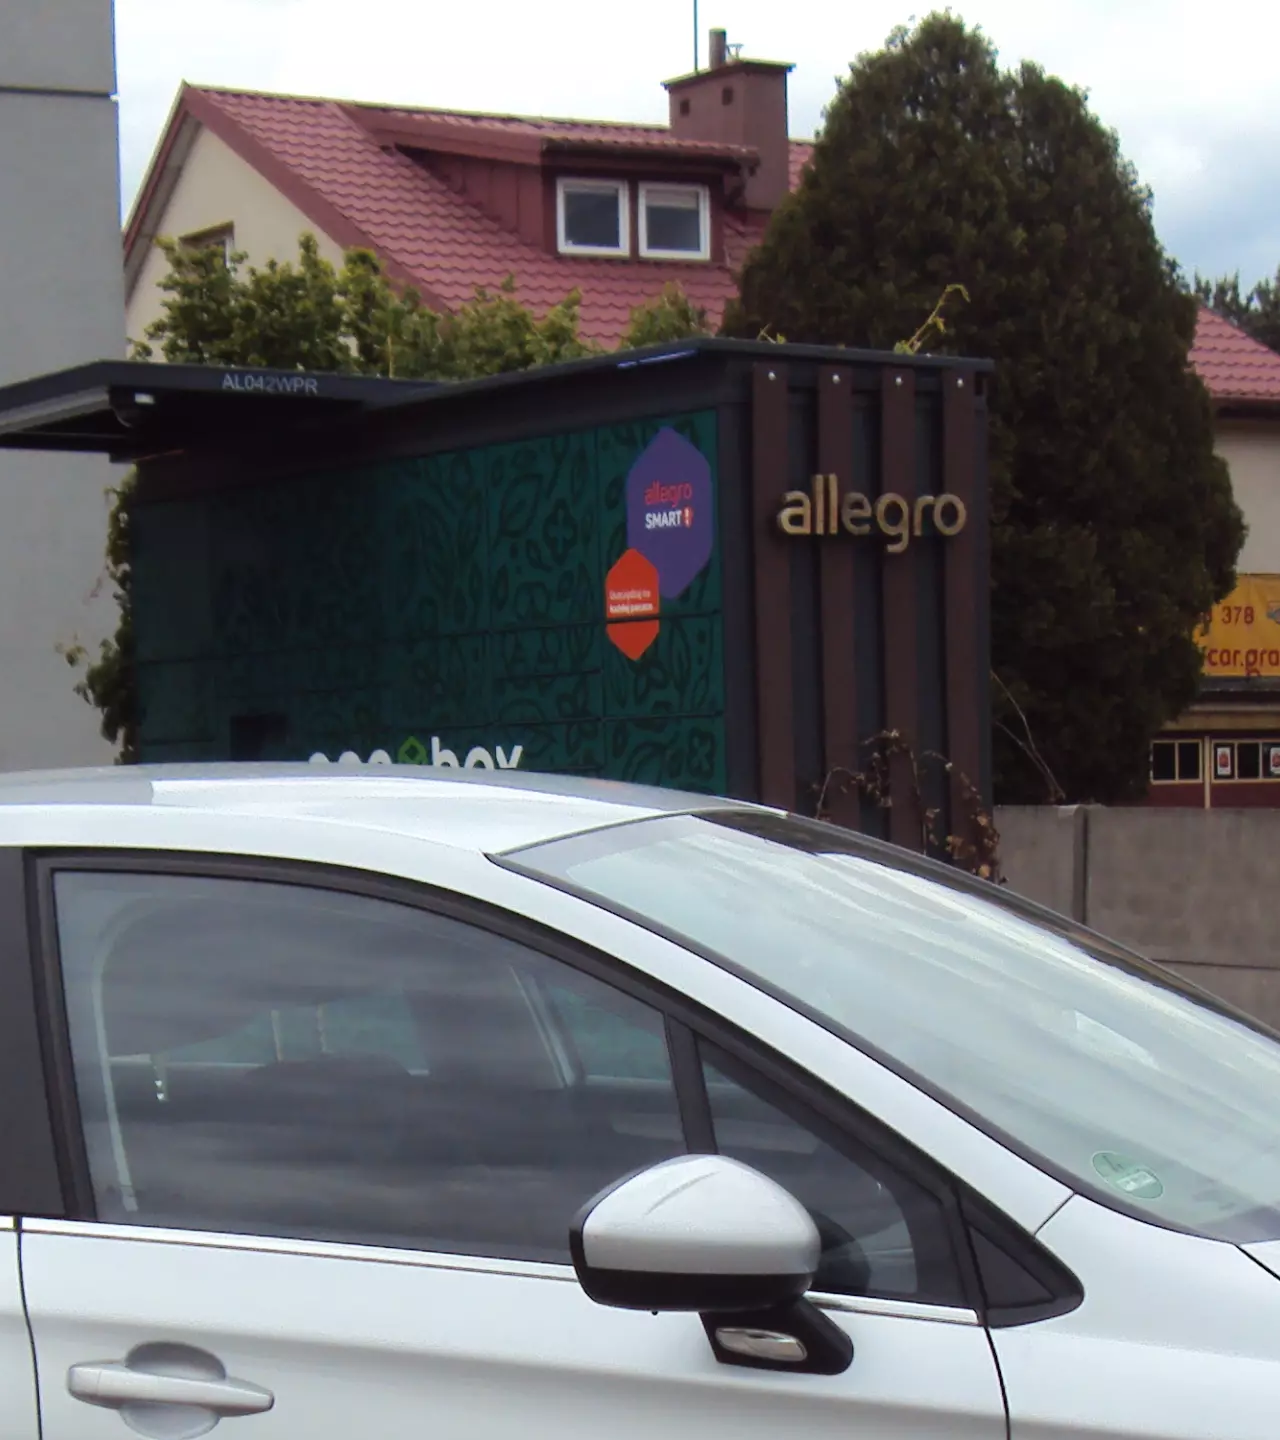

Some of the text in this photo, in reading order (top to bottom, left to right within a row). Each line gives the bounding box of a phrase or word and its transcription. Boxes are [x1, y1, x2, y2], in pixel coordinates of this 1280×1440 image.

[222, 373, 318, 395] AL042WPR
[644, 480, 693, 508] allegro
[777, 473, 966, 553] allegro
[1222, 606, 1255, 625] 378
